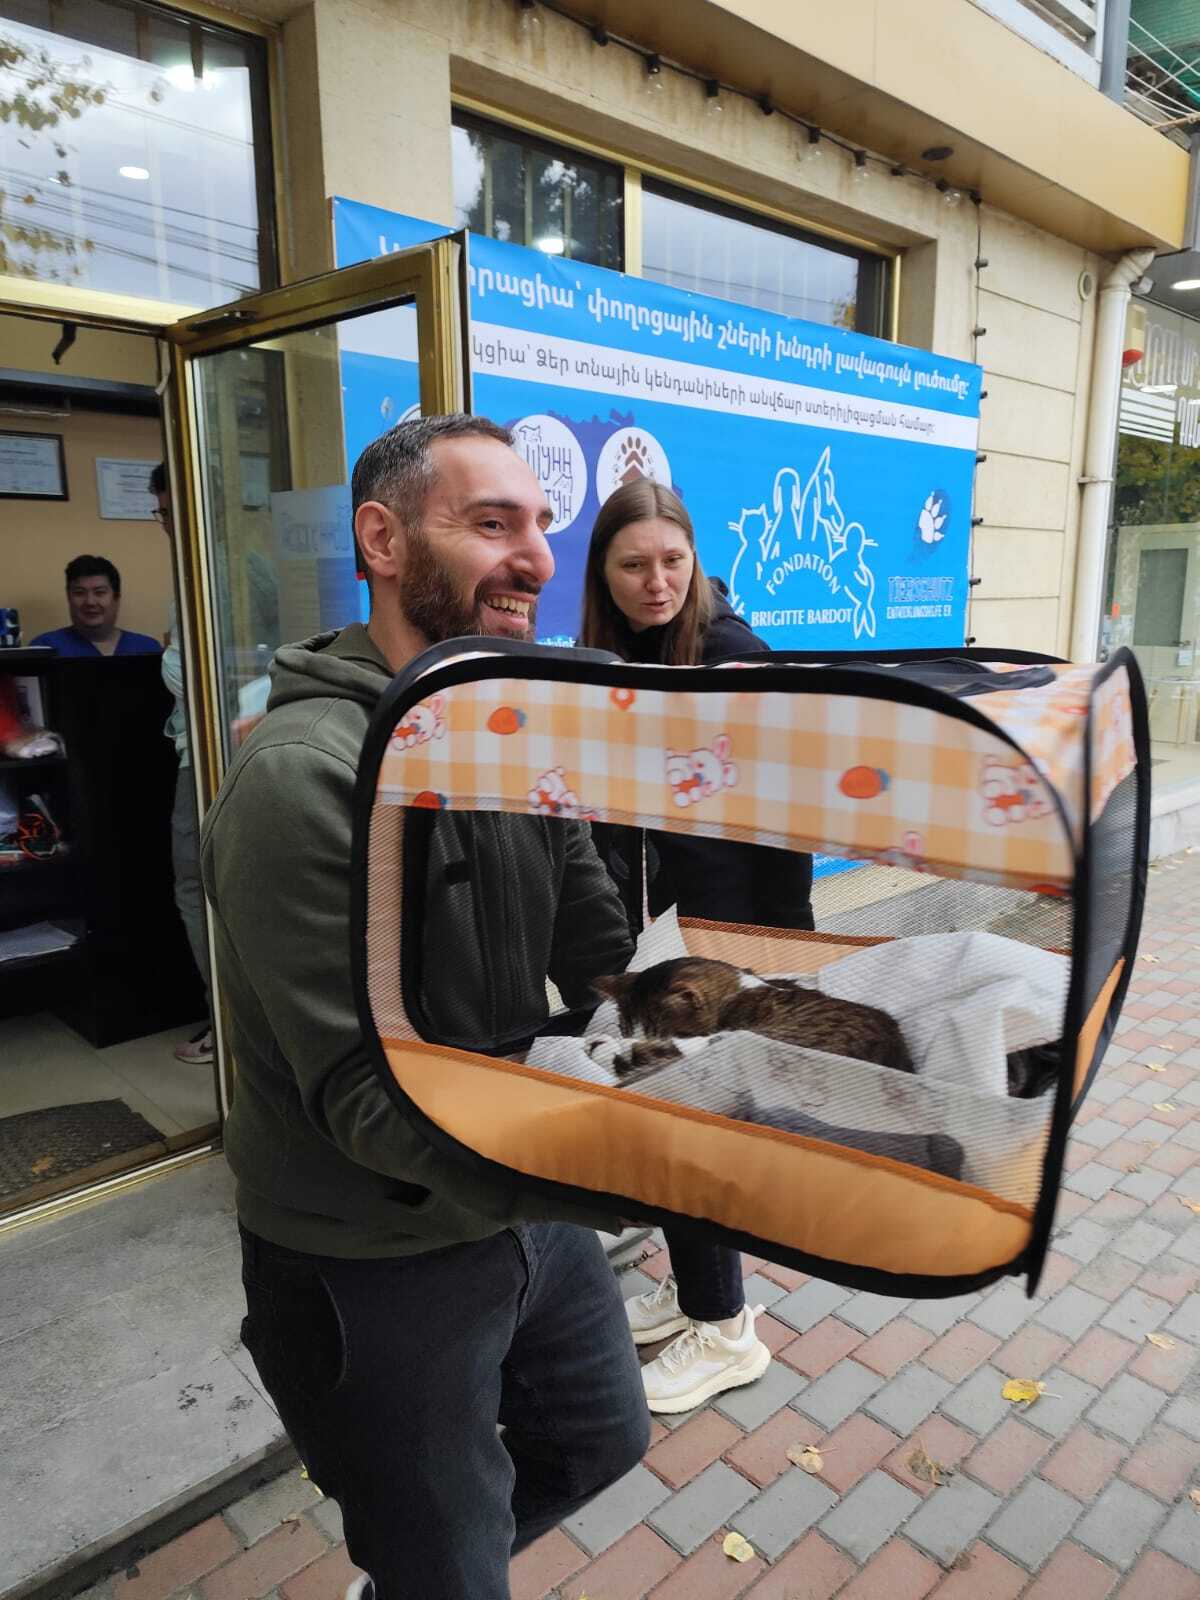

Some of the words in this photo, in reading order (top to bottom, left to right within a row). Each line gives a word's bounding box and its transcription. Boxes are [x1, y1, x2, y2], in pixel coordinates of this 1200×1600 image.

[469, 264, 581, 310] րացիա՝
[588, 288, 713, 343] փողոցային
[718, 319, 771, 358] շների
[776, 331, 832, 371] խնդրի
[836, 351, 912, 387] լավագույն
[472, 335, 531, 366] կցիա՝
[536, 349, 569, 375] Ձեր
[575, 357, 640, 386] տնային
[645, 369, 746, 406] կենդանիների
[750, 389, 802, 415] անվճար
[764, 552, 842, 596] FONDATION
[751, 609, 804, 627] BRIGITTE
[807, 607, 853, 625] BARDOT
